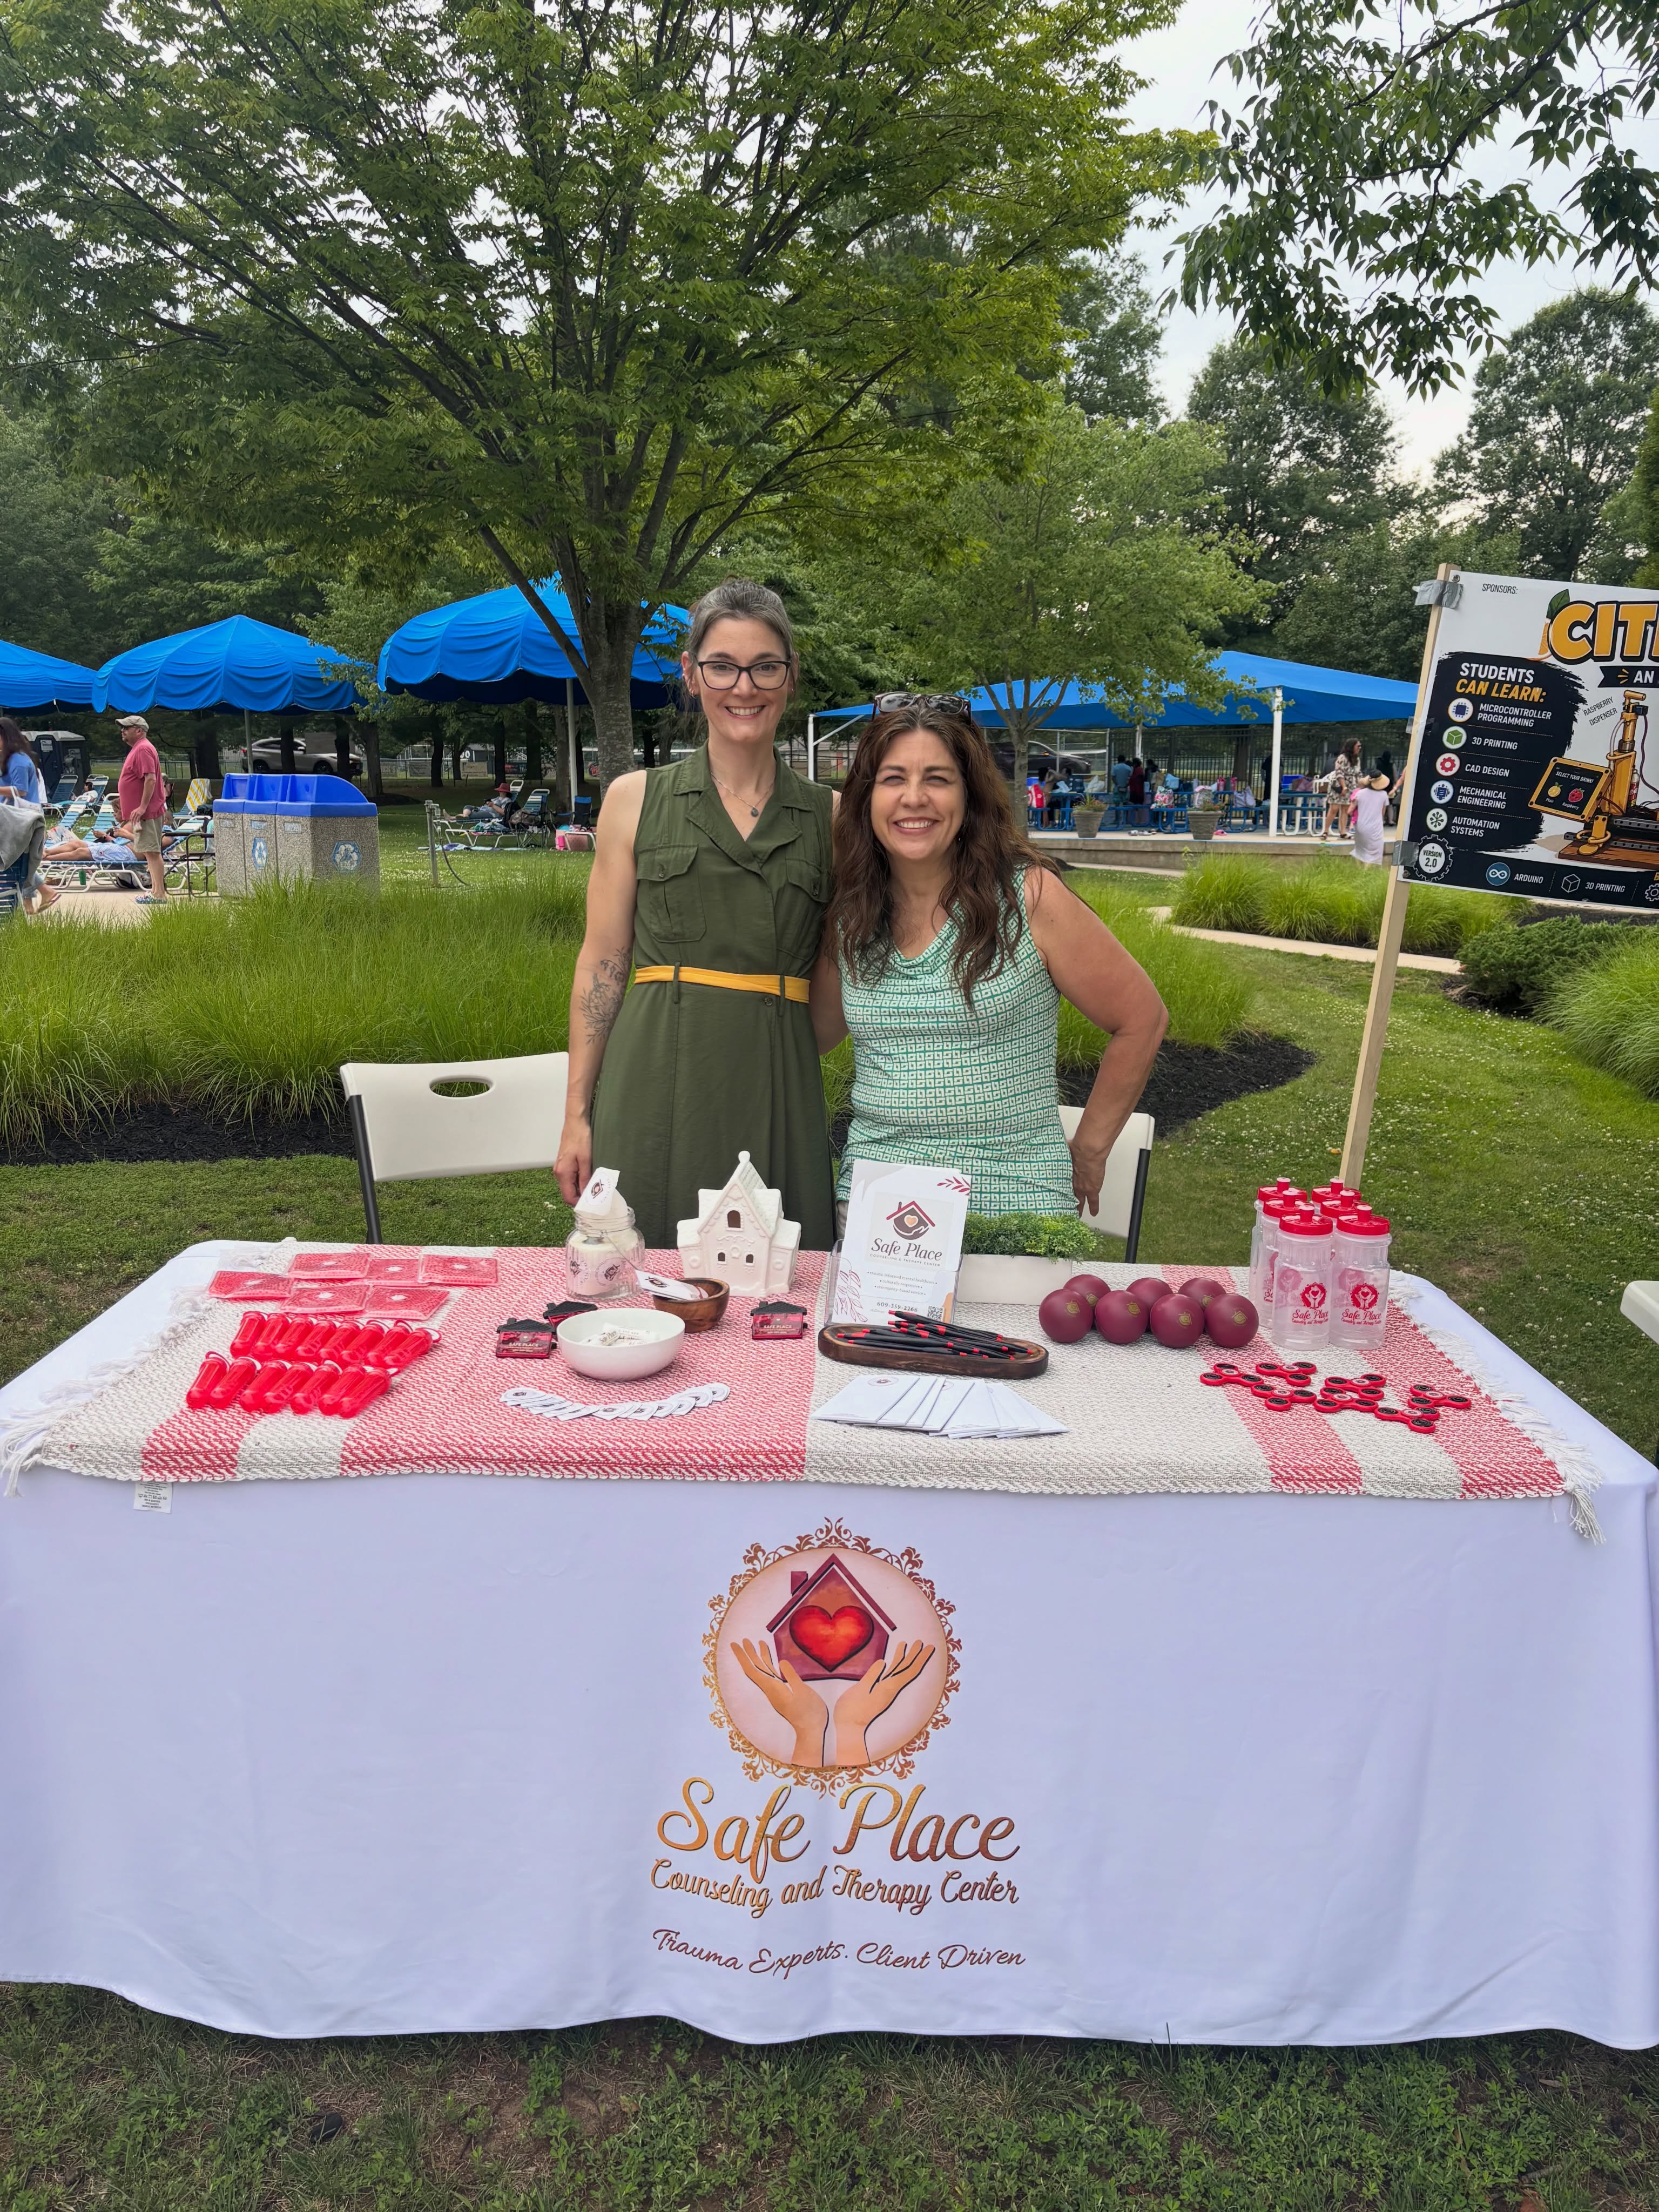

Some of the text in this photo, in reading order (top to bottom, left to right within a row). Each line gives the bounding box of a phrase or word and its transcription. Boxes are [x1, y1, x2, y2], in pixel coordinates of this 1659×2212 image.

[1482, 583, 1518, 595] SPONSORS:
[1549, 601, 1659, 664] CIT
[1460, 662, 1535, 684] STUDENTS
[1633, 670, 1655, 684] AN
[1455, 678, 1547, 703] CAN LEARN:
[1479, 703, 1552, 720] MICROCONTROLLER
[1583, 696, 1614, 717] RASPBERRY
[1477, 712, 1535, 727] PROGRAMMING
[1589, 707, 1618, 726] DISPENSER
[1472, 737, 1518, 750] 3D PRINTING
[1465, 764, 1510, 777] CAD DESIGN
[1555, 771, 1570, 779] SELECT
[1459, 786, 1507, 800] MECHANICAL
[1457, 795, 1507, 809] ENGINEERING
[1452, 816, 1500, 830] AUTOMATION
[1451, 825, 1485, 837] SYSTEMS
[1422, 849, 1442, 859] VERSION
[1425, 857, 1438, 868] 2.0
[1514, 873, 1543, 884] ARDUINO
[1585, 881, 1626, 893] 3D PRINTING
[871, 1238, 942, 1261] Safe Place
[1292, 1309, 1311, 1321] Safe
[1342, 1308, 1360, 1321] Safe
[657, 1776, 1021, 1884] Safe Place
[650, 1858, 1020, 1919] Counseling and Therapy Center
[652, 1928, 1026, 1980] Trauma Experts. Client Driven
